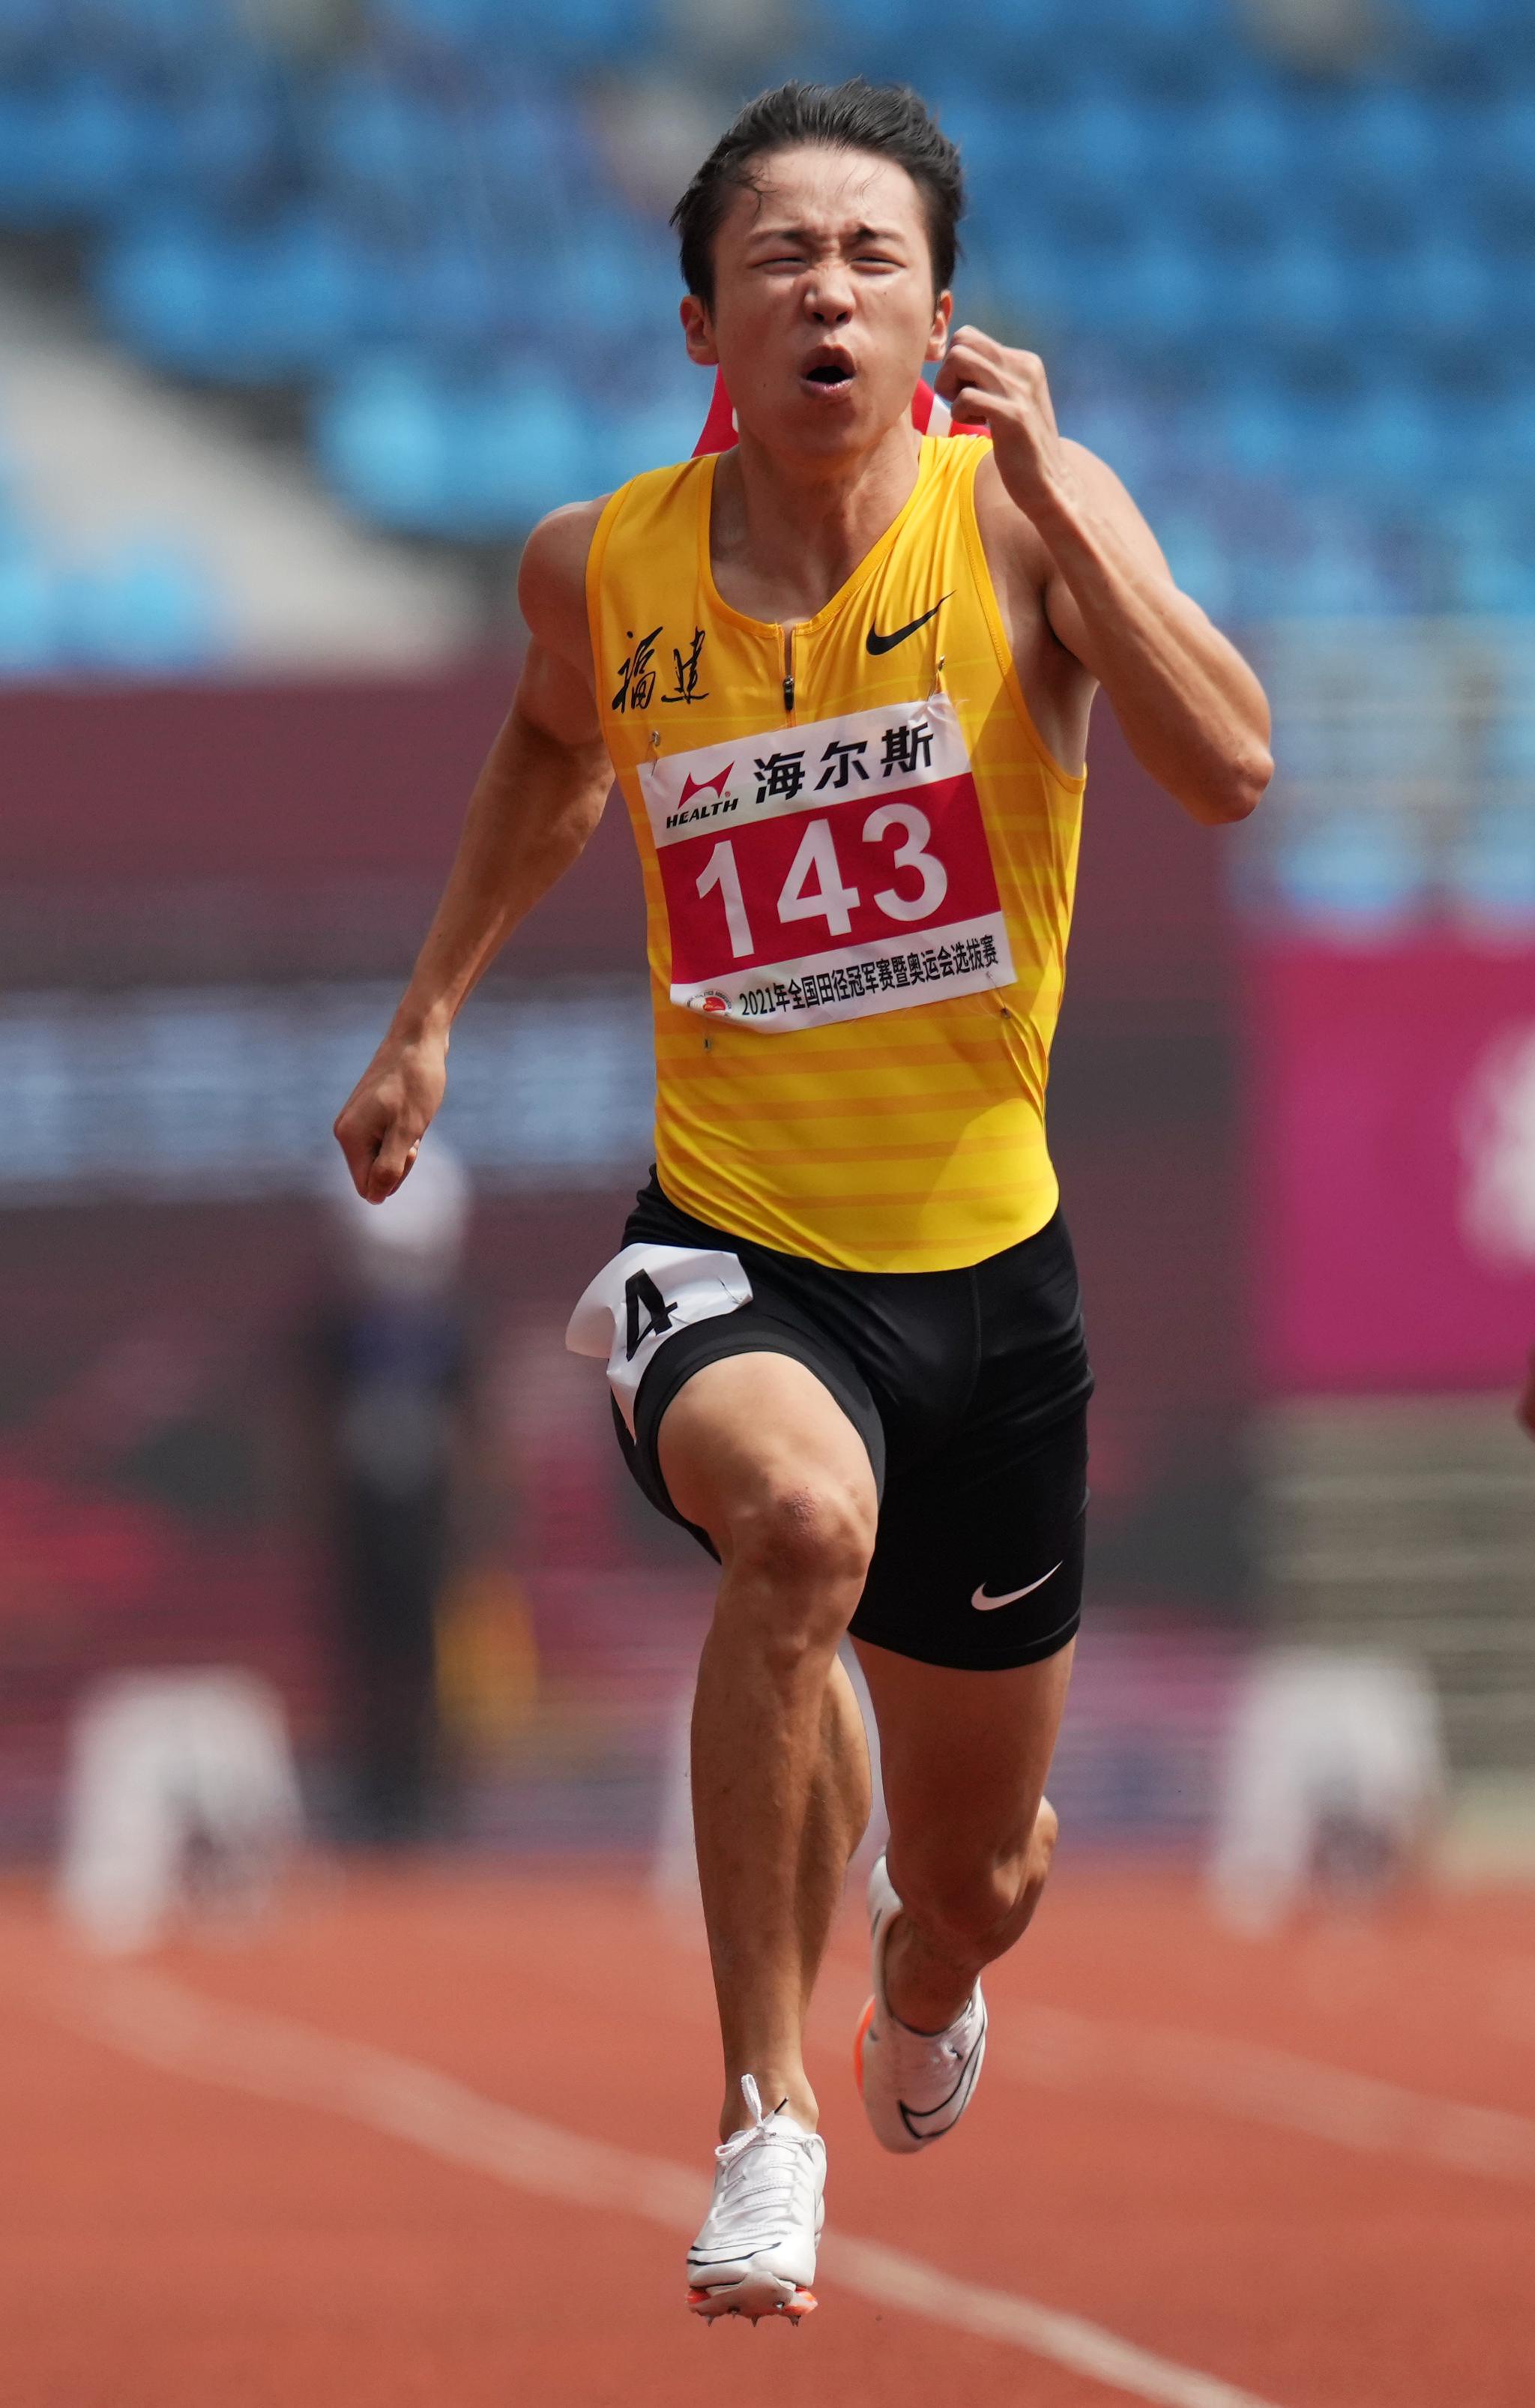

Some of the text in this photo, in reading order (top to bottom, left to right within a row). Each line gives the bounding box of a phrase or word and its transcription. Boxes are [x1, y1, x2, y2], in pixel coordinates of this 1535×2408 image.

[612, 626, 709, 714] 福建
[753, 722, 934, 804] 海尔斯
[666, 798, 738, 828] HEALTH
[696, 803, 948, 958] 143
[739, 935, 999, 1016] 2021年全国田径冠军赛暨奥运会选拔赛
[625, 1268, 678, 1362] 4
